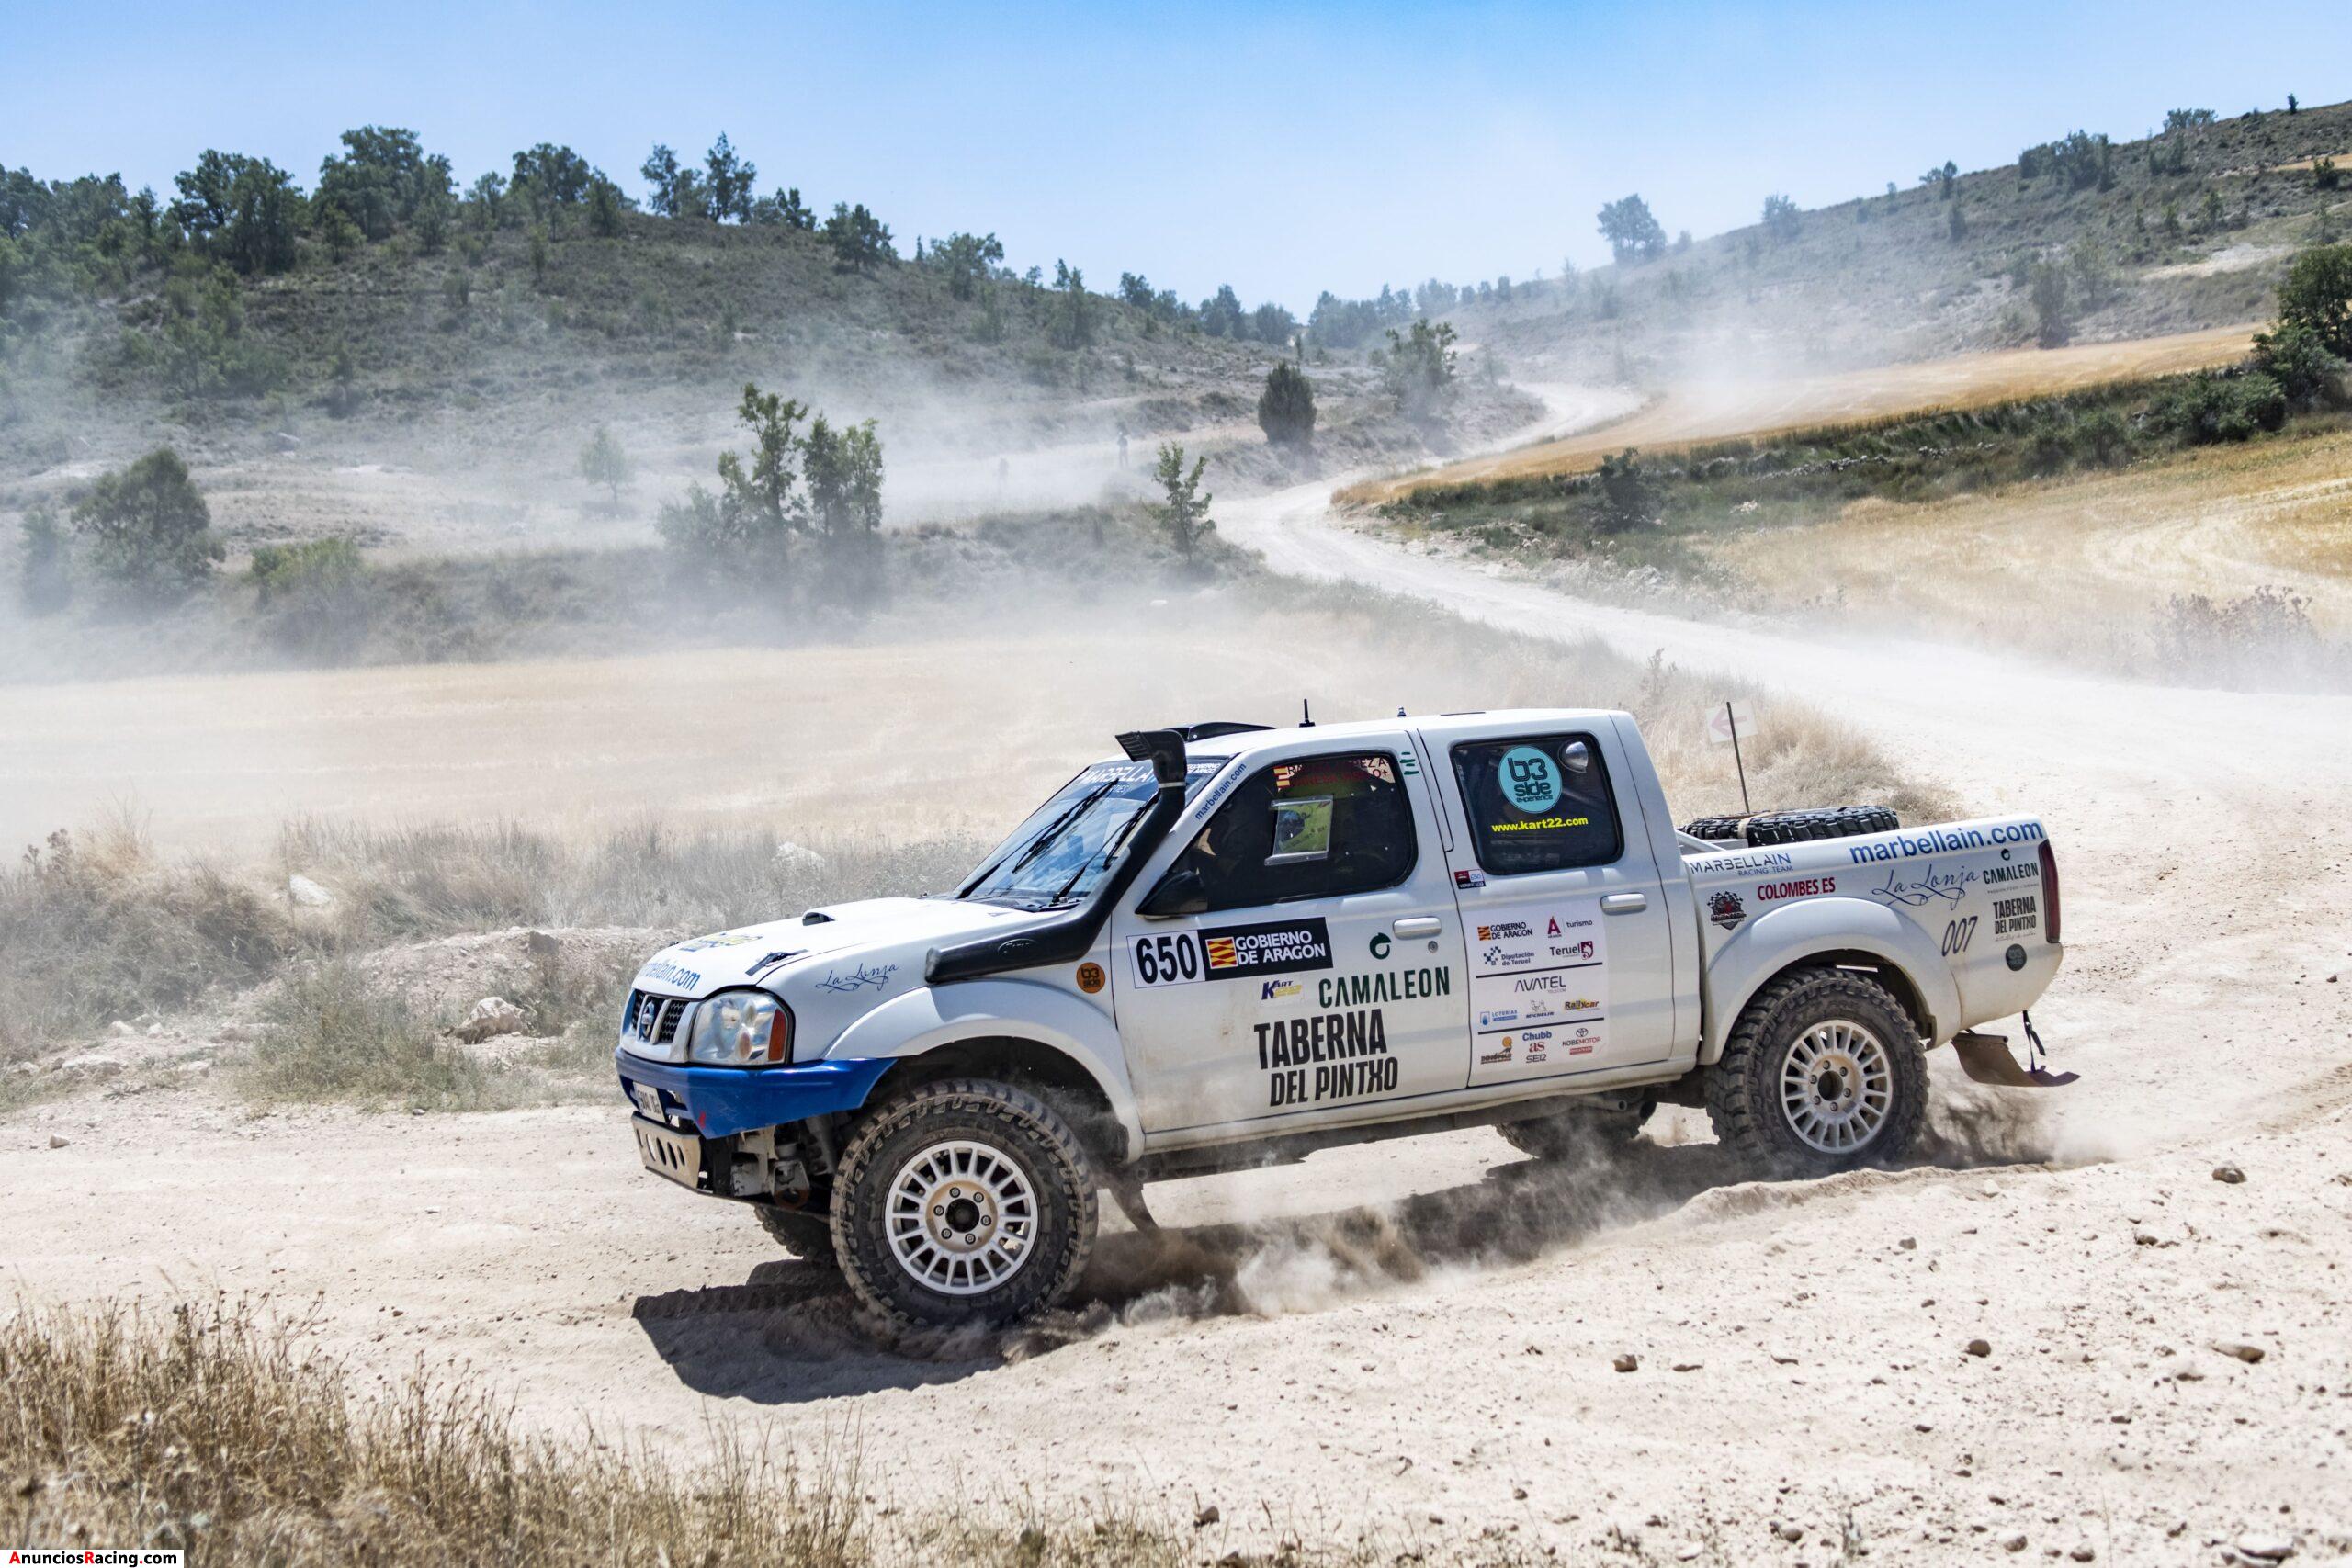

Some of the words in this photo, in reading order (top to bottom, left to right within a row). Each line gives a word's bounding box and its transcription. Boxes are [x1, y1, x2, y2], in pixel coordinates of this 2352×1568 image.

[1507, 758, 1548, 782] b3
[1194, 763, 1247, 820] marbellain.com
[1514, 781, 1552, 796] side
[1491, 818, 1589, 832] www.kart22.com
[1849, 822, 2044, 863] marbellain.com
[1690, 853, 1792, 874] MARBELLAIN
[1773, 864, 1793, 873] TEAM
[1983, 863, 2039, 884] CAMALEON
[1758, 877, 1836, 901] COLOMBES.ES
[1911, 864, 1981, 911] Lonja
[1993, 896, 2036, 919] TABERNA
[1490, 922, 1526, 931] GOBIERNO
[1503, 929, 1533, 938] ARAGON
[1995, 919, 2007, 934] DEL
[2009, 915, 2036, 931] PINTXO
[1235, 930, 1312, 951] GOBIERNO
[1941, 916, 1978, 956] 007
[1136, 934, 1198, 984] 650
[1238, 952, 1259, 965] DE
[1262, 943, 1326, 964] ARAGON
[1549, 943, 1580, 956] Teruel
[1318, 966, 1450, 1009] CAMALEON
[1514, 976, 1566, 992] AVATEL
[1254, 1009, 1387, 1070] TABERNA
[1522, 1031, 1553, 1041] Chubb
[1563, 1037, 1600, 1046] KOBEMOTOR
[1529, 1042, 1544, 1053] as
[1526, 1054, 1546, 1064] SER
[1270, 1070, 1308, 1107] DEL
[1315, 1057, 1398, 1100] PINTXO
